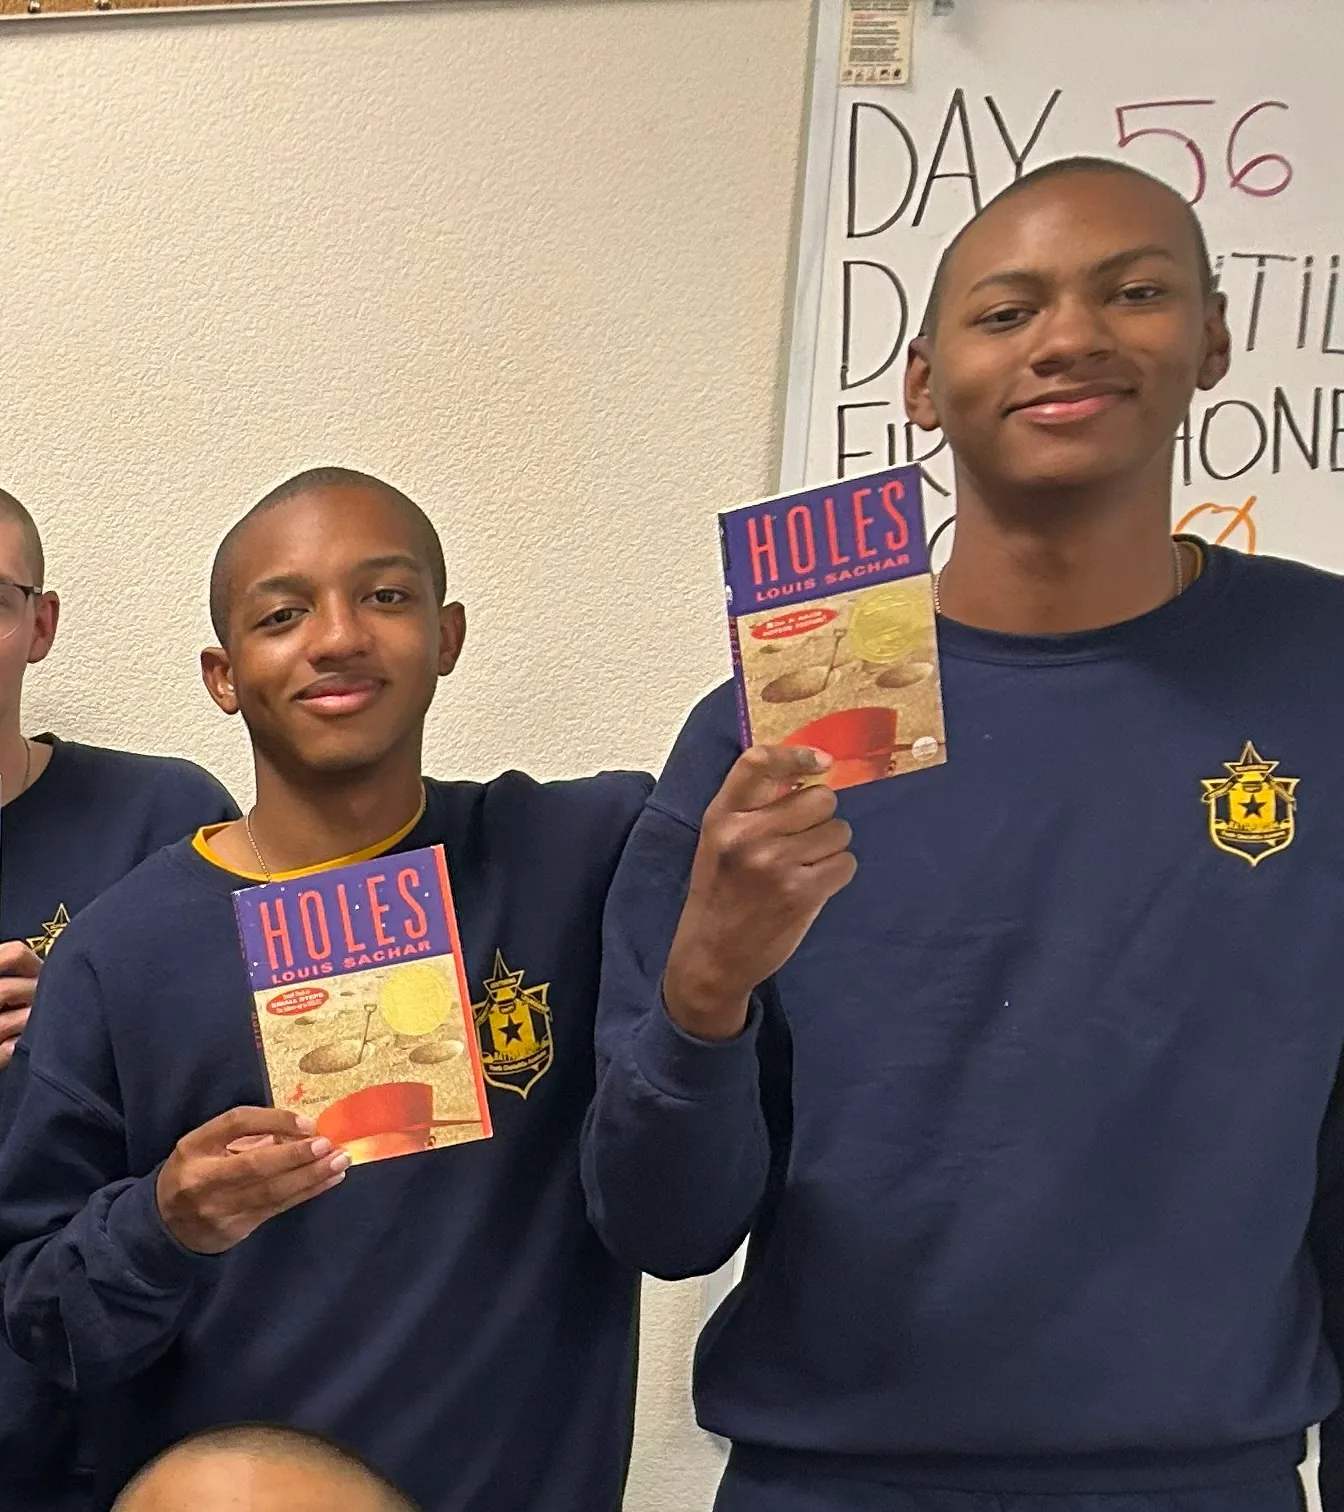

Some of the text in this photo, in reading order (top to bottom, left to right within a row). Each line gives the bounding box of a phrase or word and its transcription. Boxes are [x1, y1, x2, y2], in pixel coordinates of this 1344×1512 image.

[846, 87, 1294, 238] DAY 56
[746, 479, 909, 586] HOLES
[756, 554, 910, 602] LOUIS SACHAR
[259, 868, 428, 970] HOLES
[271, 940, 432, 985] LOUIS SACHAR
